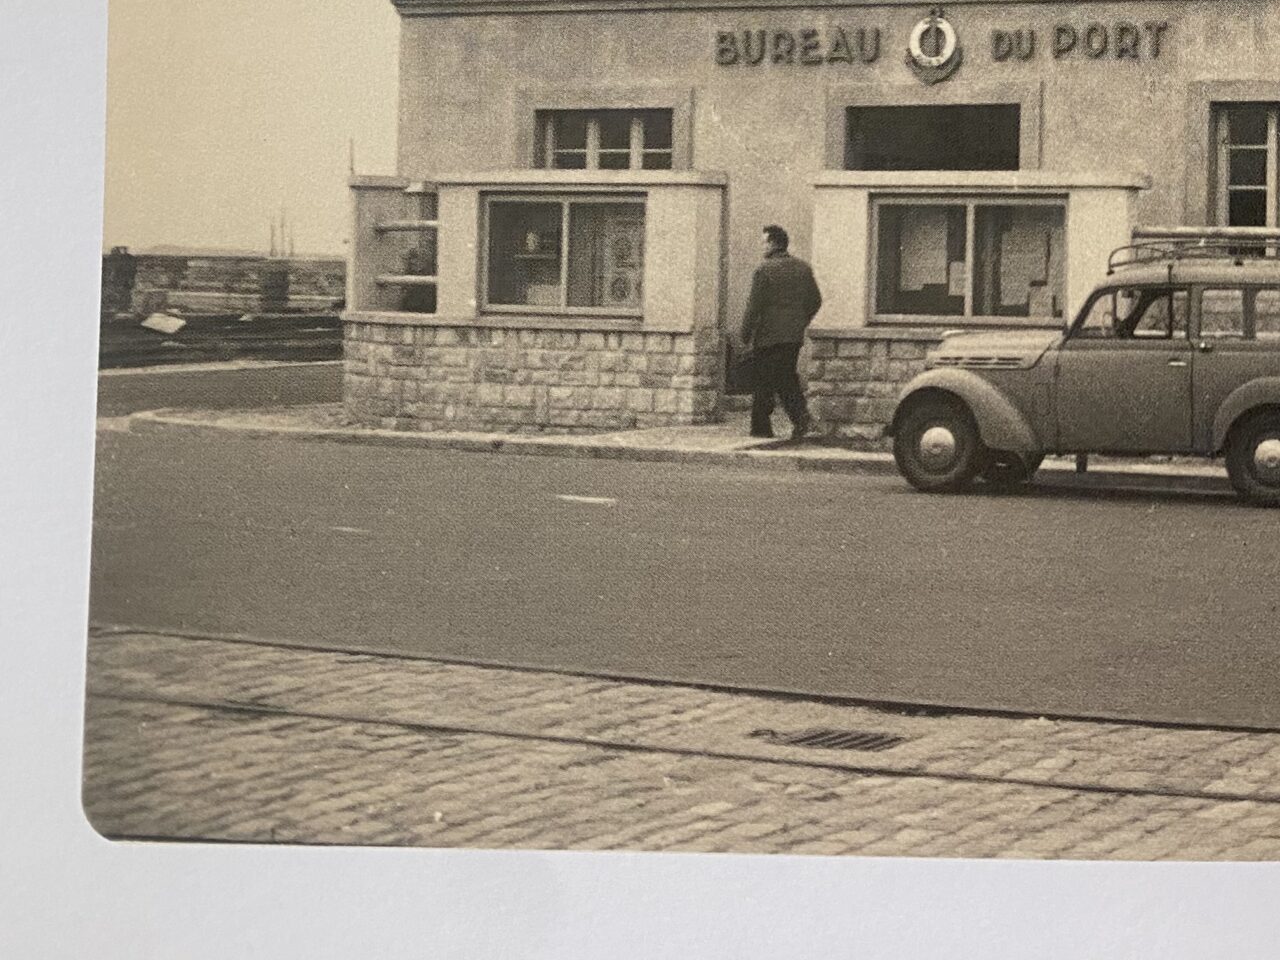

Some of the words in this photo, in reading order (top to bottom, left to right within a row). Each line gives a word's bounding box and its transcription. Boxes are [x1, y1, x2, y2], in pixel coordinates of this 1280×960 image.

[714, 27, 881, 65] BUREAU
[991, 28, 1036, 62] DU
[1052, 21, 1168, 59] PORT
